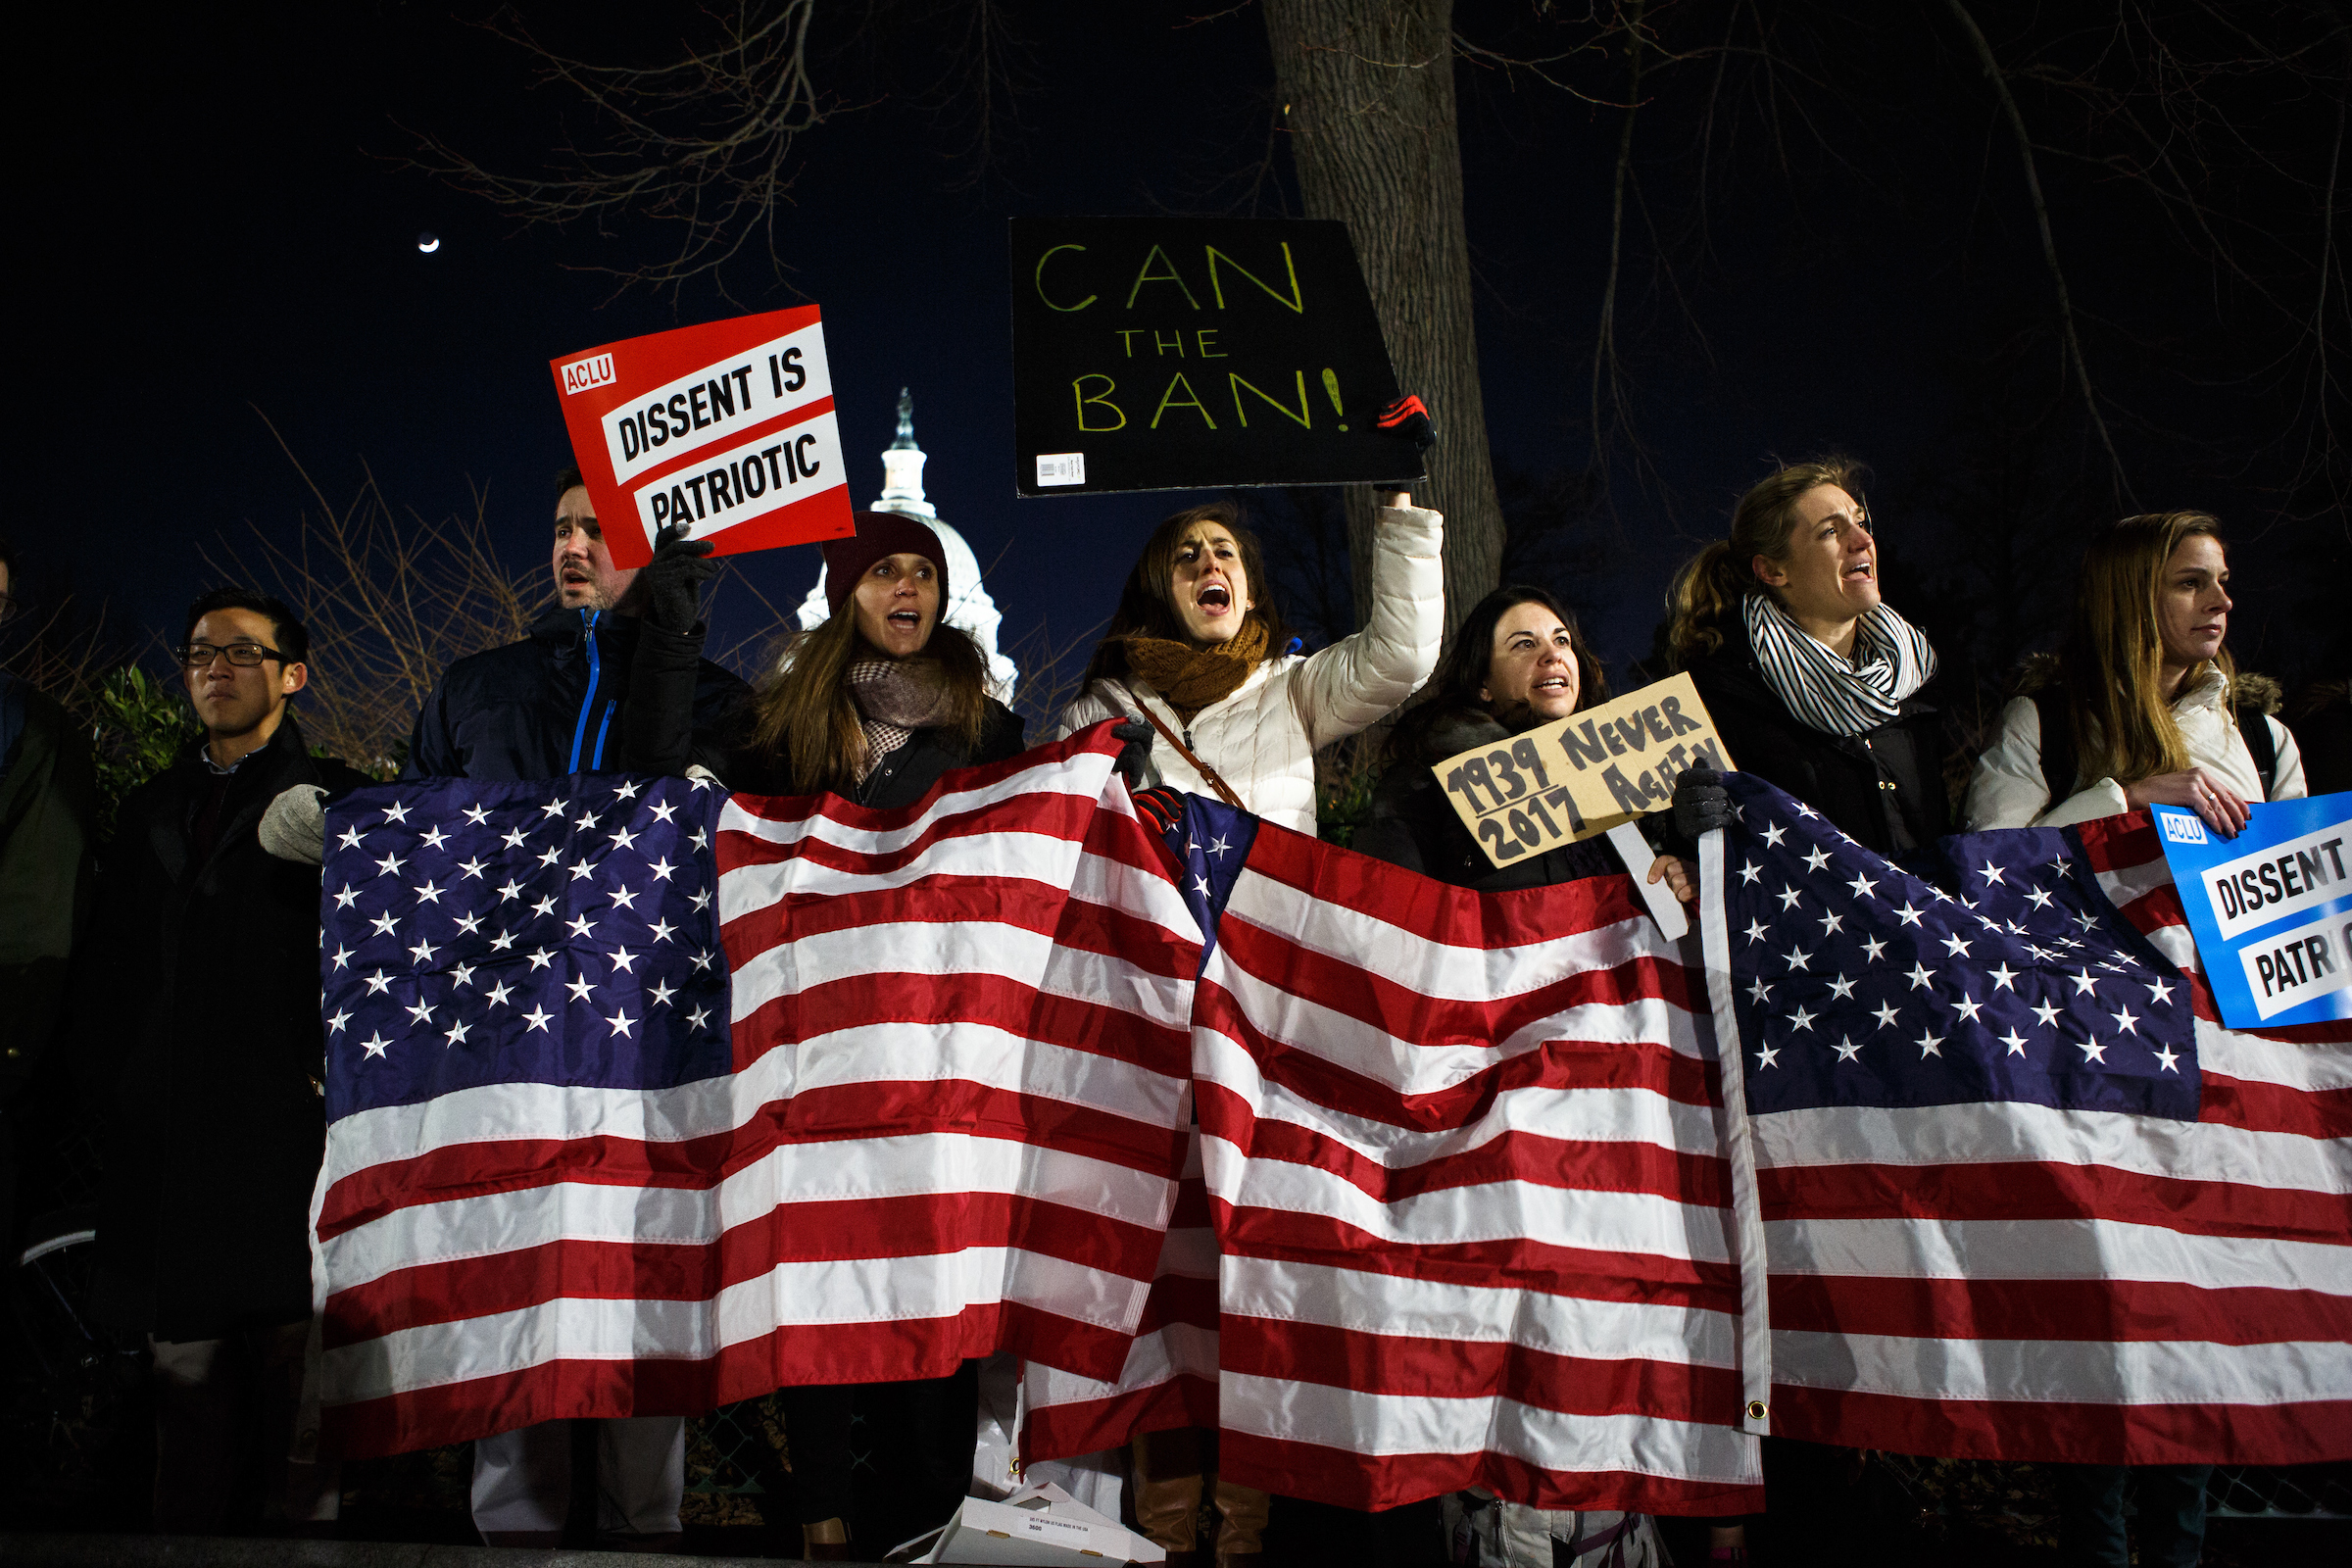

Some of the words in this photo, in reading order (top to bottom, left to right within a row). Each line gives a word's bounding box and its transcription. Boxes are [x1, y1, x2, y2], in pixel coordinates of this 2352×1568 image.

[1035, 241, 1304, 315] CAN
[566, 356, 612, 392] ACLU
[1114, 328, 1229, 359] THE
[618, 364, 753, 463] DISSENT
[768, 347, 807, 399] IS
[1072, 367, 1349, 432] BAN!
[651, 433, 820, 530] PATRIOTIC
[1446, 737, 1550, 815] 1939
[1557, 695, 1702, 771] NEVER
[1478, 785, 1587, 860] 2017
[2166, 815, 2203, 842] ACLU
[2216, 837, 2347, 920] DISSENT
[2255, 921, 2352, 998] PATR
